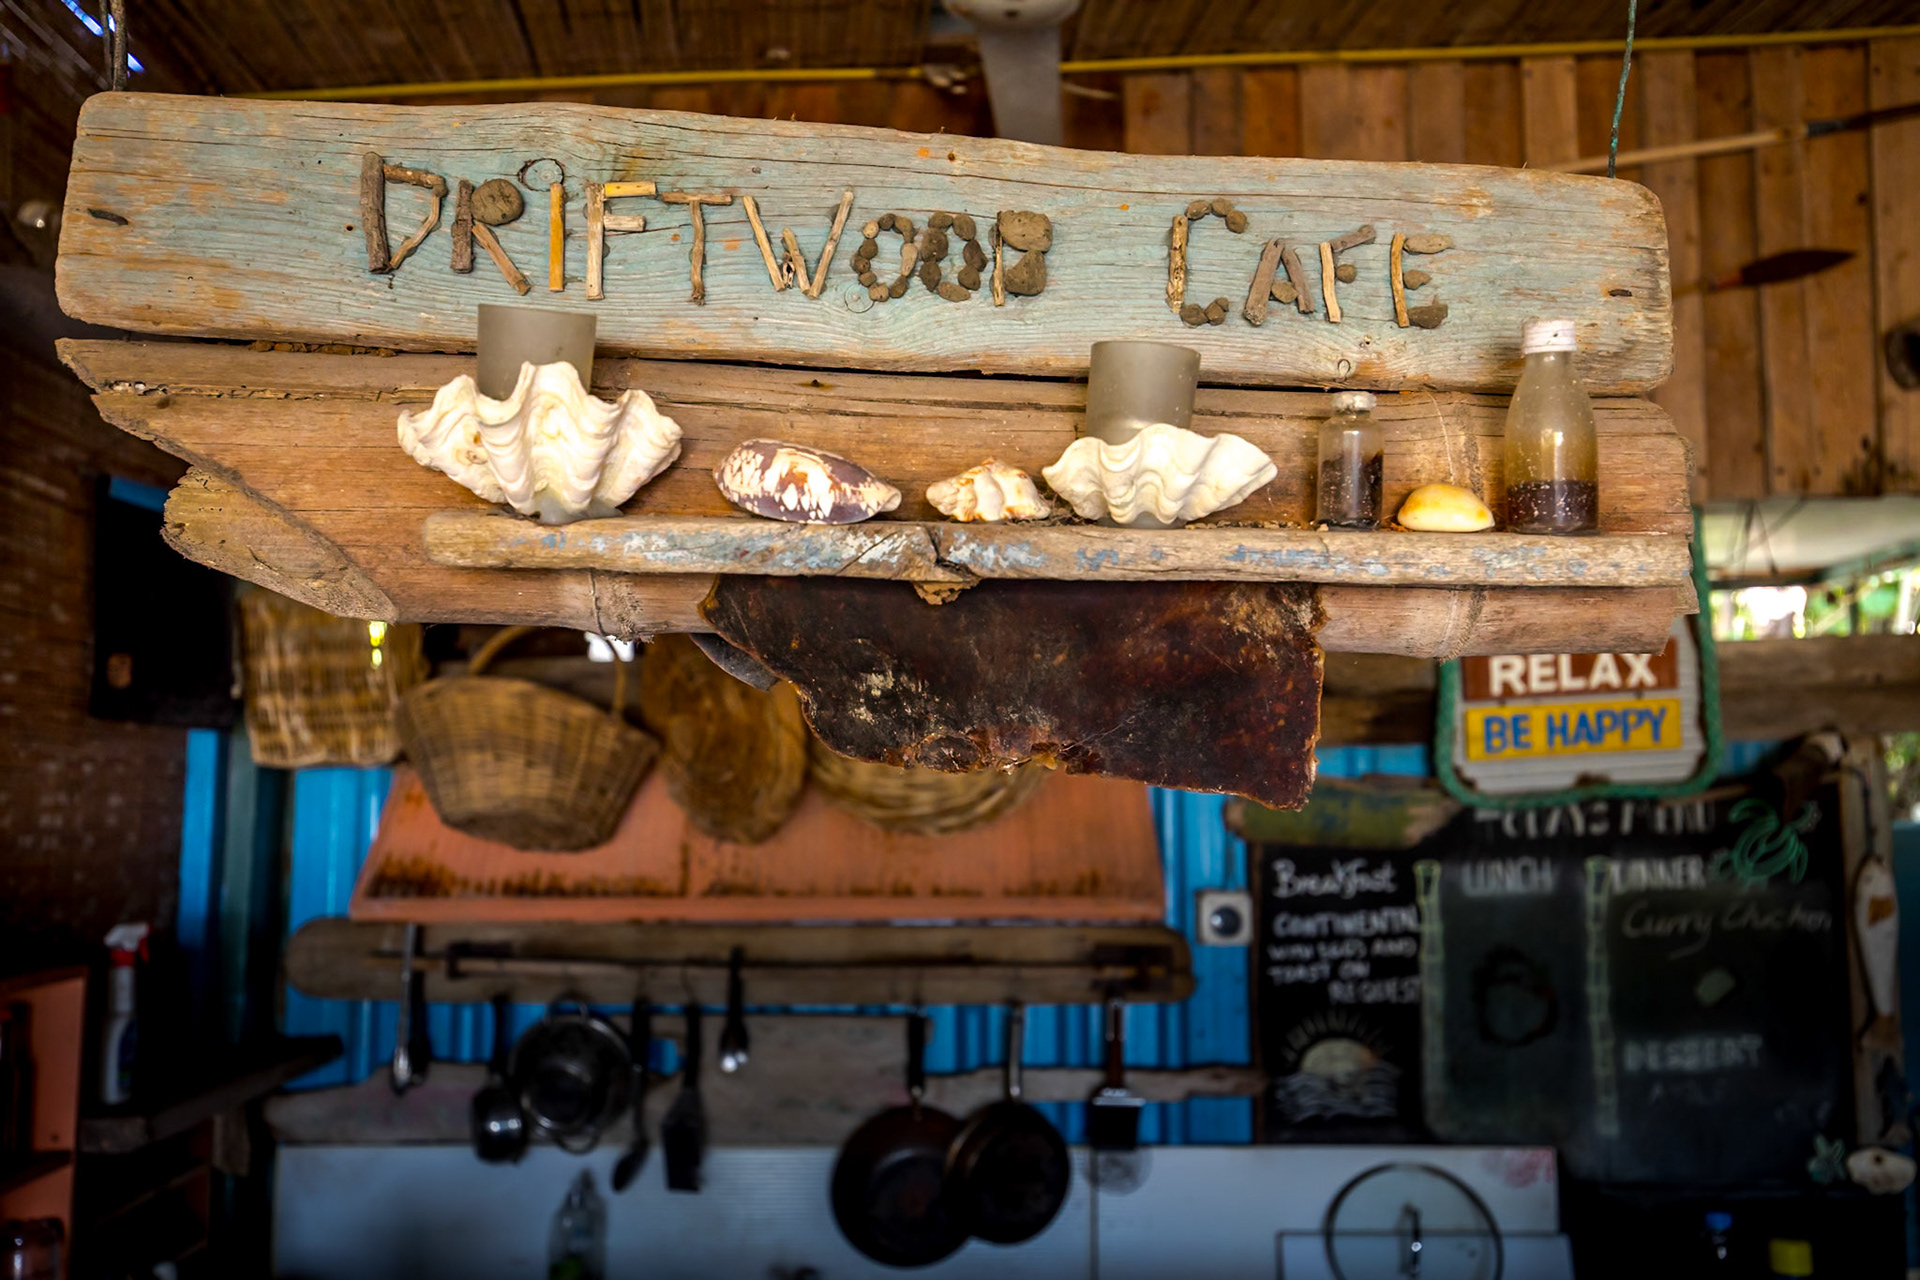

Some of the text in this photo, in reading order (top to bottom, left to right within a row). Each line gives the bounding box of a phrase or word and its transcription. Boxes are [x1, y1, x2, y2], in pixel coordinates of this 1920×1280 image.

[1166, 197, 1453, 328] CAFE
[1489, 653, 1657, 697] RELAX
[1484, 707, 1664, 755] BE HAPPY
[1461, 856, 1556, 897] LUNCH
